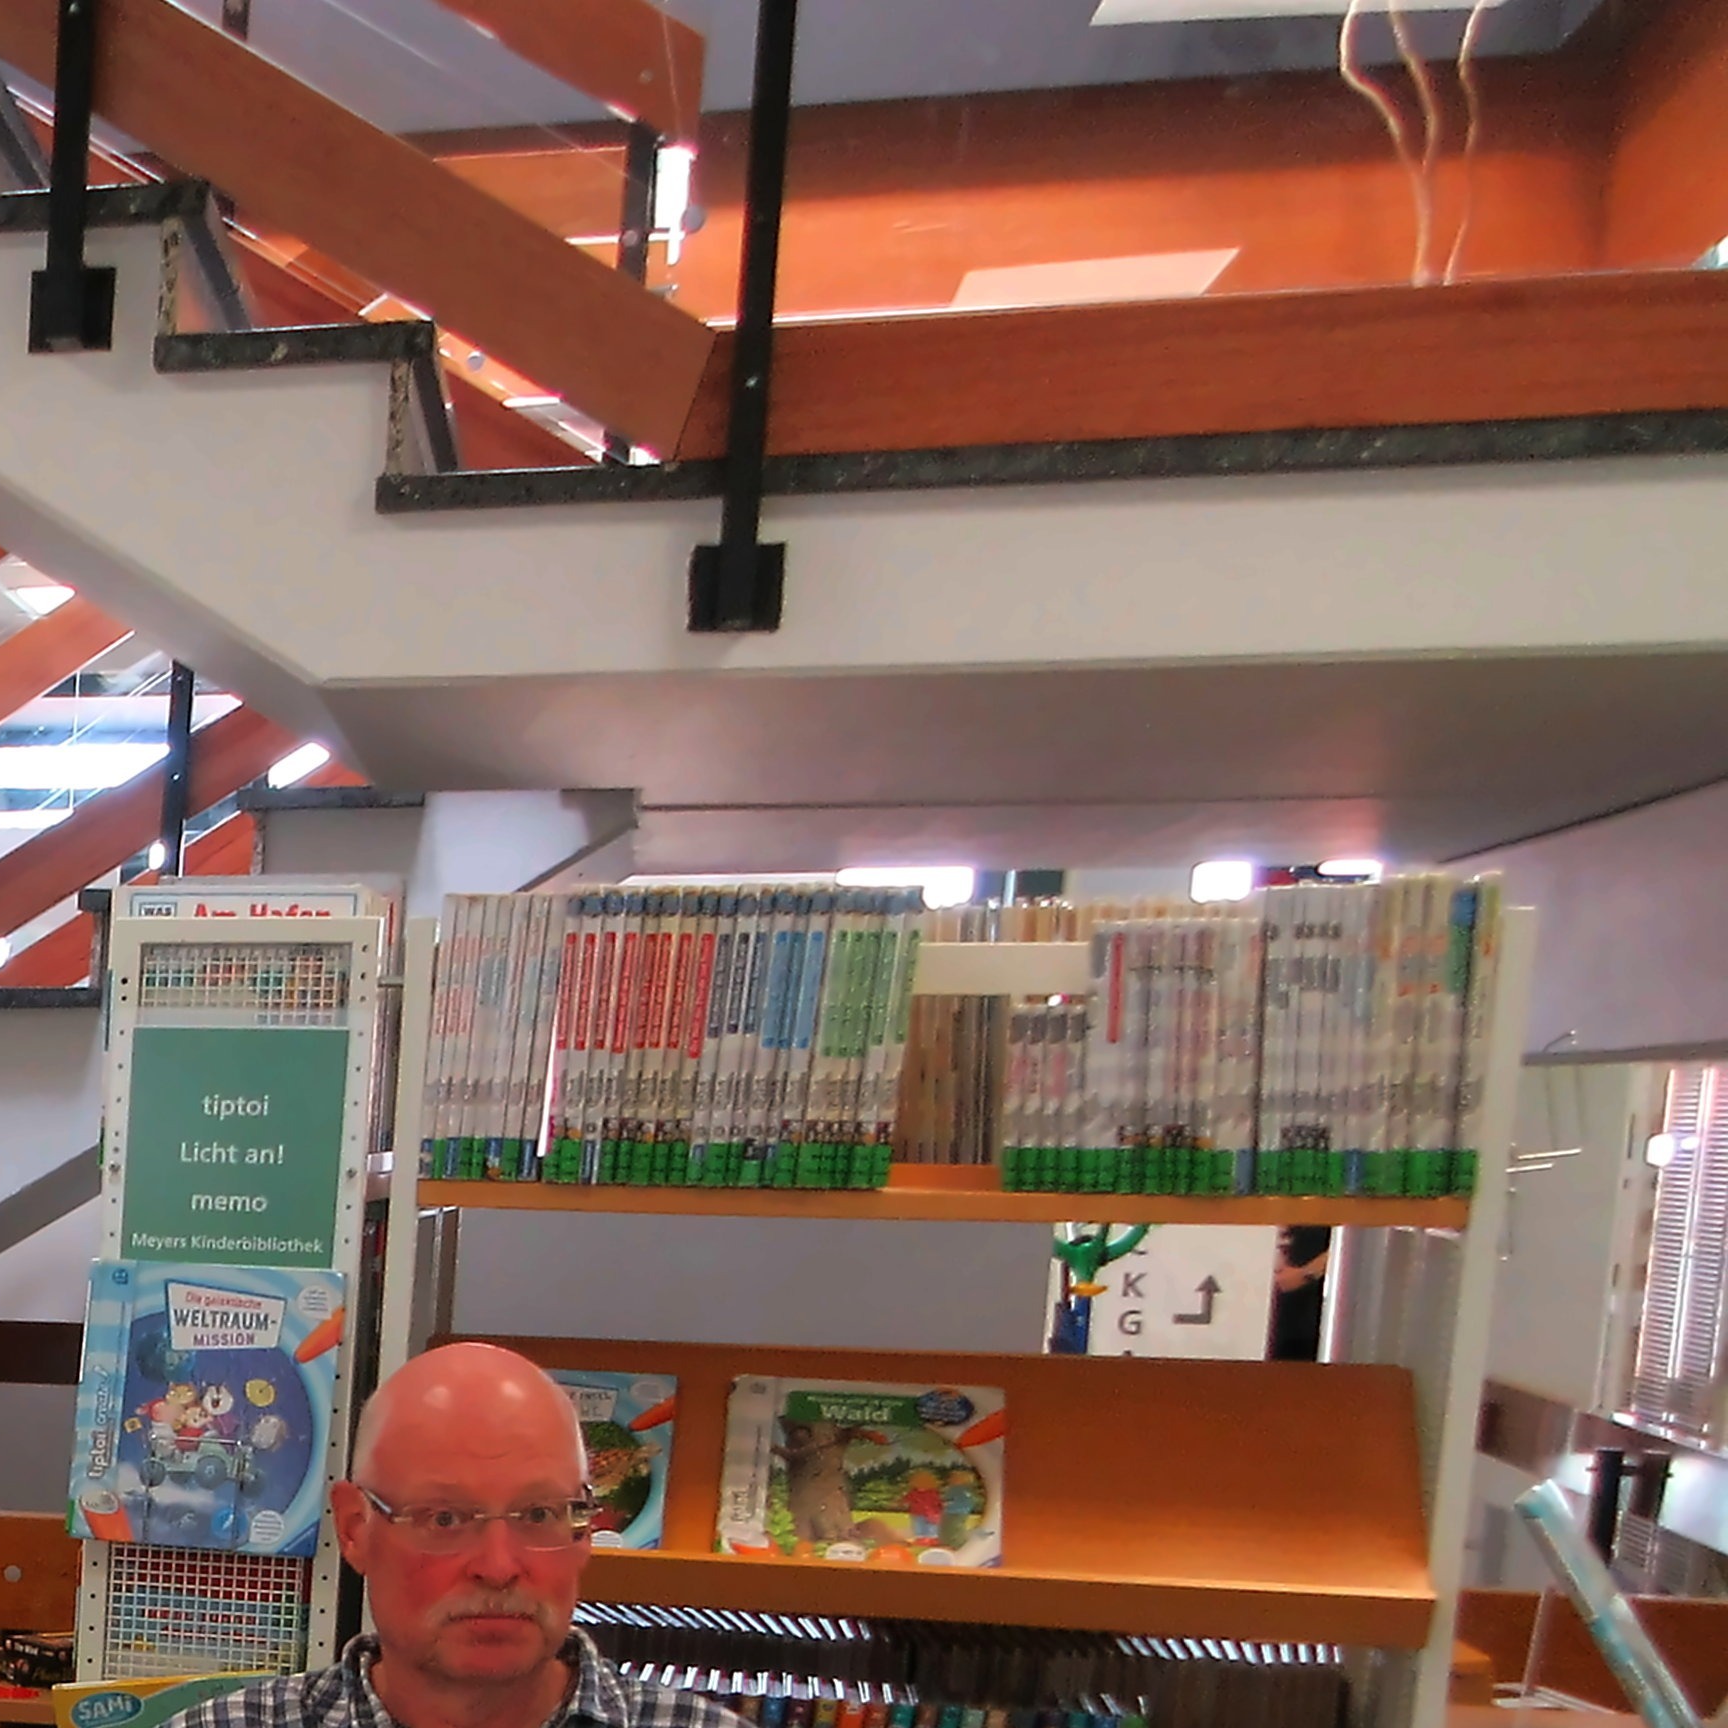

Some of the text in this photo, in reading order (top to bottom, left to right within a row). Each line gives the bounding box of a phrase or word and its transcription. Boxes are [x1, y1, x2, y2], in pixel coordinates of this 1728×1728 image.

[202, 1094, 270, 1120] tiptoi
[180, 1142, 284, 1164] Licht an!
[191, 1194, 268, 1213] memo
[132, 1233, 323, 1254] Meyers Kinderbibliothek
[1121, 1272, 1148, 1298] K
[174, 1308, 278, 1331] WELTRAUM-
[1118, 1310, 1142, 1335] G
[193, 1333, 255, 1347] MISSION
[821, 1404, 890, 1422] Wald
